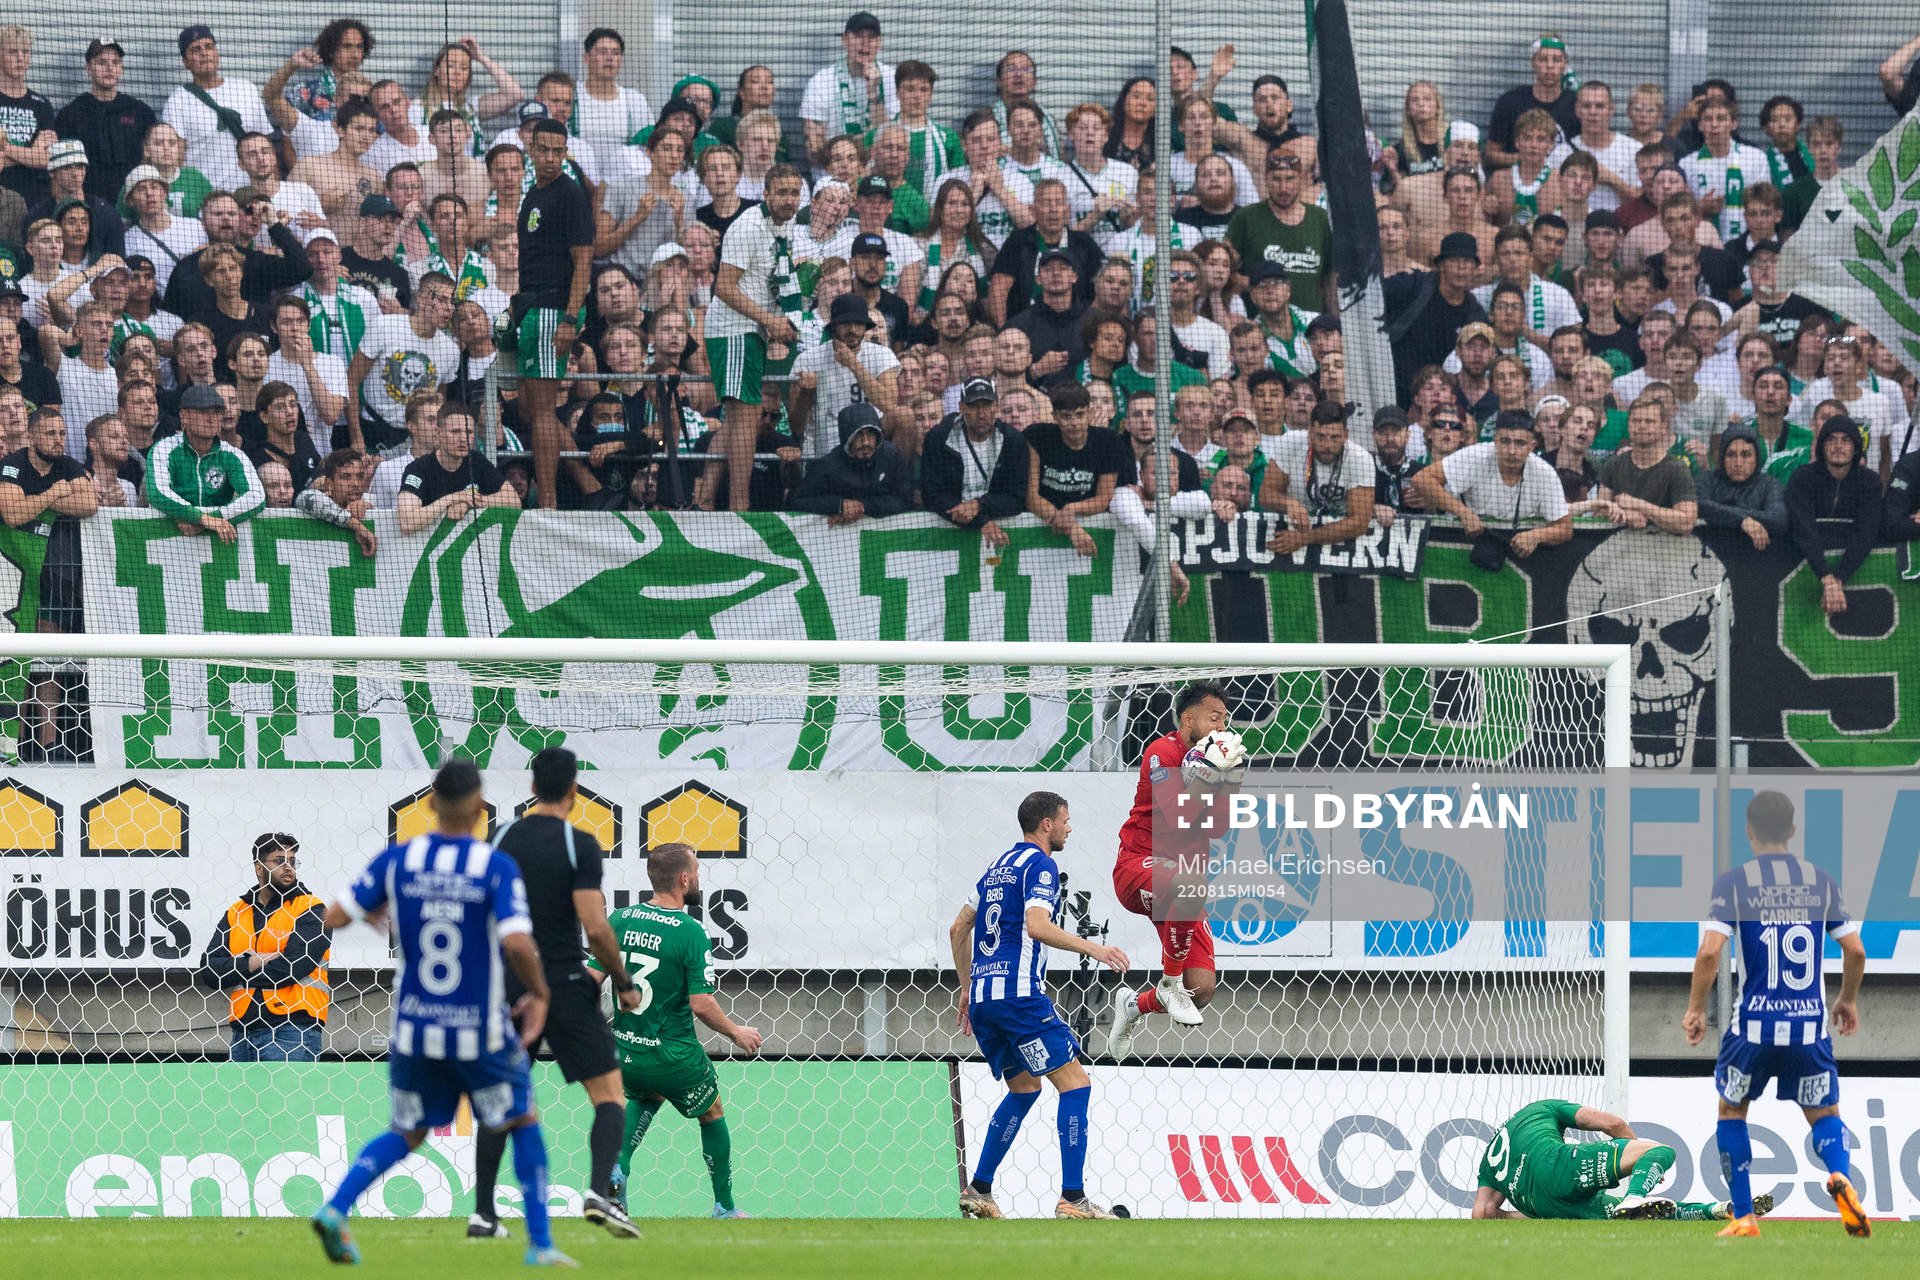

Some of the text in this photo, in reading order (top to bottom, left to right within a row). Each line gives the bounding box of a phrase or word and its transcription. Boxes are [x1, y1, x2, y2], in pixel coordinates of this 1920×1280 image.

[986, 887, 1005, 902] BERG
[1758, 885, 1810, 896] NORDIC
[1748, 895, 1822, 908] WELLNESS
[631, 908, 683, 927] limitado
[1760, 907, 1811, 926] CARNEIL
[979, 903, 1002, 956] 9
[623, 930, 662, 952] FENGER
[418, 919, 463, 996] 8
[1760, 925, 1815, 991] 19
